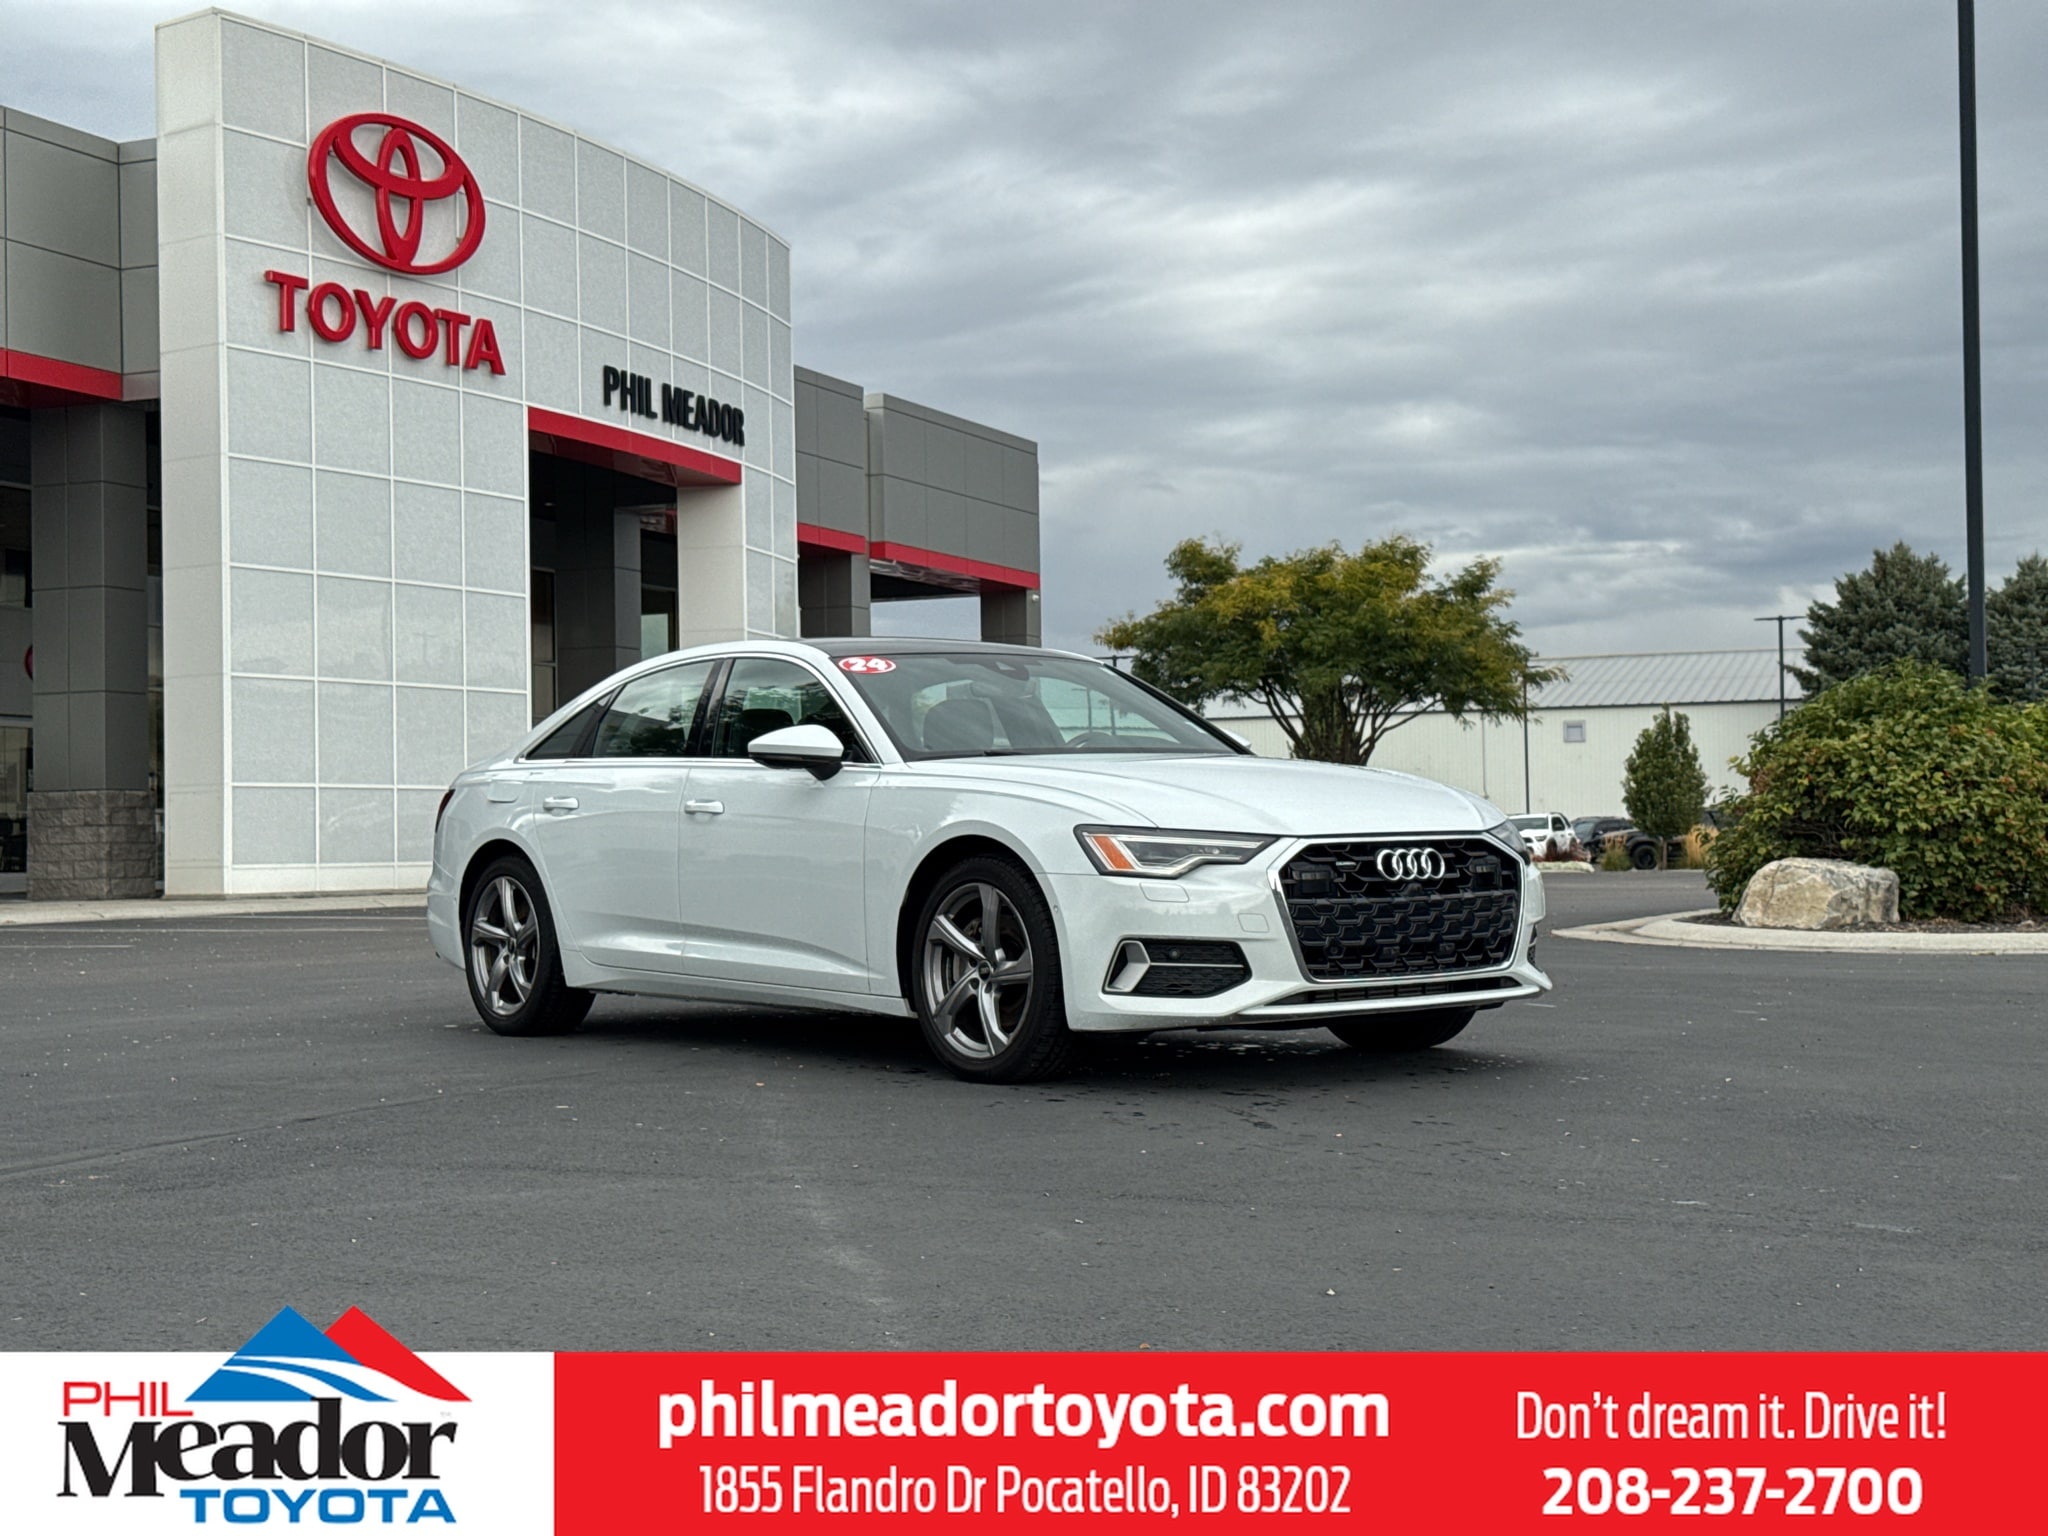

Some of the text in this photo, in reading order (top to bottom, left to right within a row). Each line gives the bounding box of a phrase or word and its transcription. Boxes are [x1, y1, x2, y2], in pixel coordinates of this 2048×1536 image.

[264, 270, 506, 376] TOYOTA
[603, 365, 745, 447] PHIL MEADOR
[848, 657, 888, 671] 24
